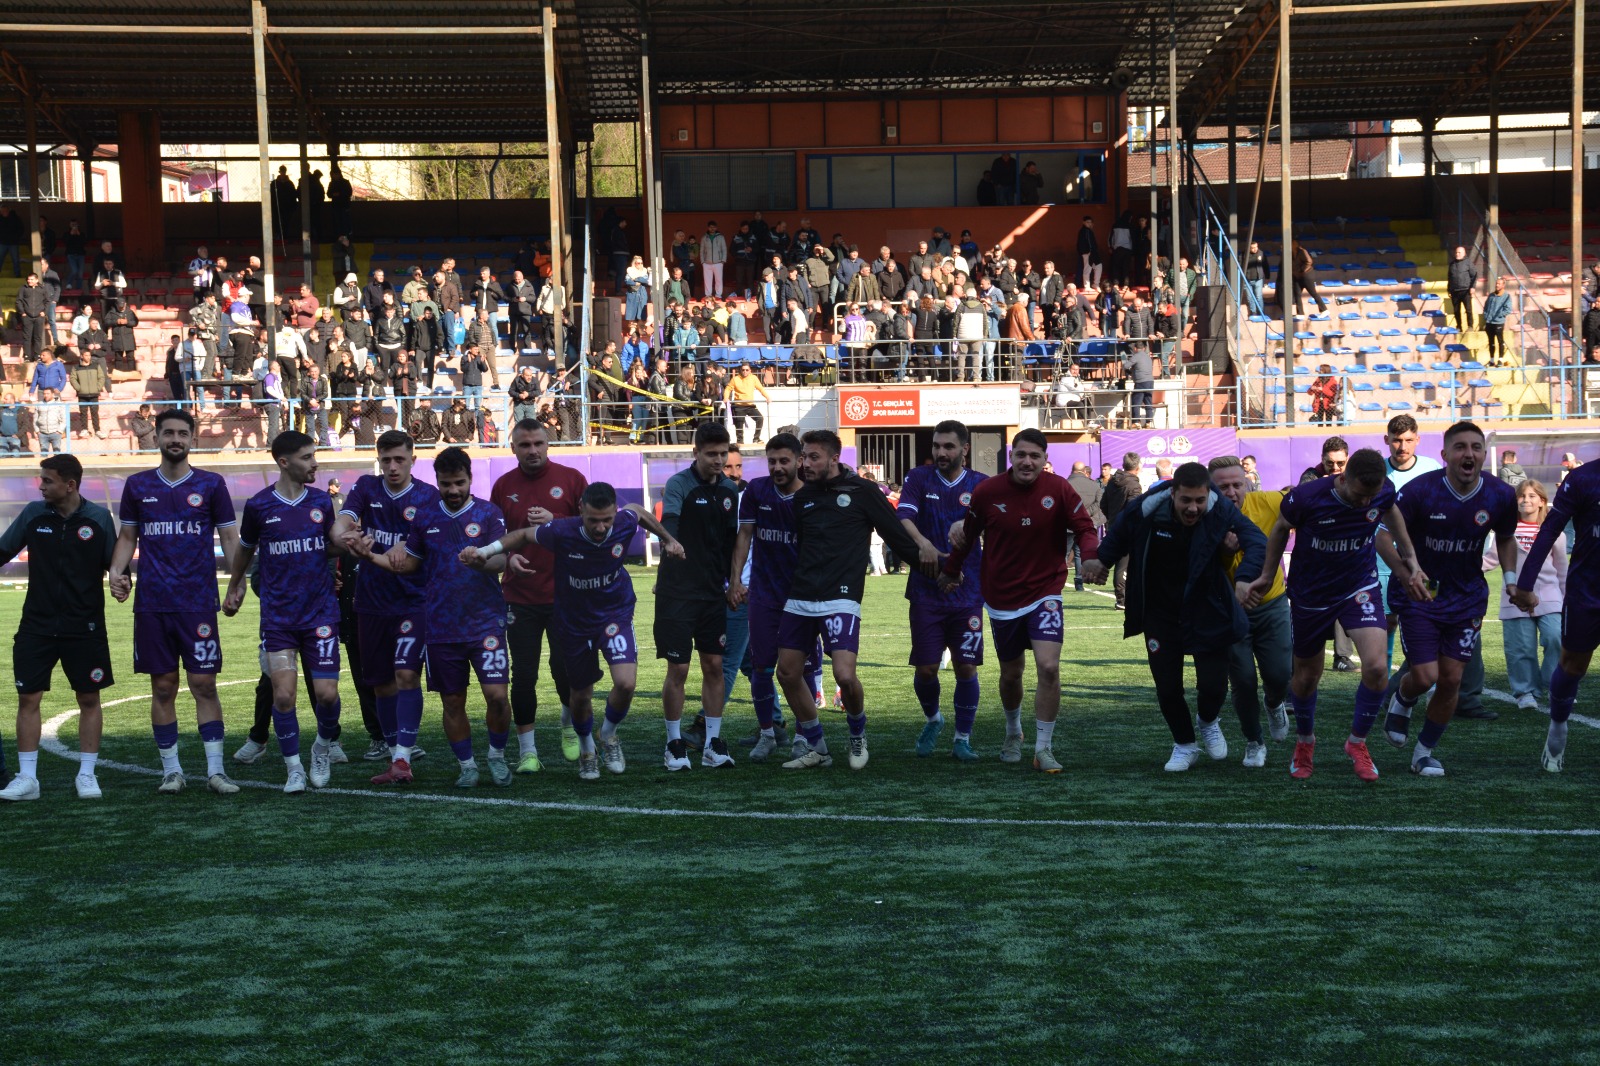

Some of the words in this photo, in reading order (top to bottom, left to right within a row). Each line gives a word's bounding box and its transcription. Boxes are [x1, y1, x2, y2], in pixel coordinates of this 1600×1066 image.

[144, 522, 172, 536] NORTH
[756, 526, 782, 542] NORTH
[268, 539, 302, 555] NORTH
[1312, 538, 1348, 552] NORTH
[569, 576, 600, 589] NORTH
[840, 586, 848, 594] 12
[1361, 601, 1376, 614] 9
[1038, 610, 1062, 629] 23
[960, 632, 982, 652] 27
[194, 640, 218, 662] 52
[482, 649, 506, 670] 25
